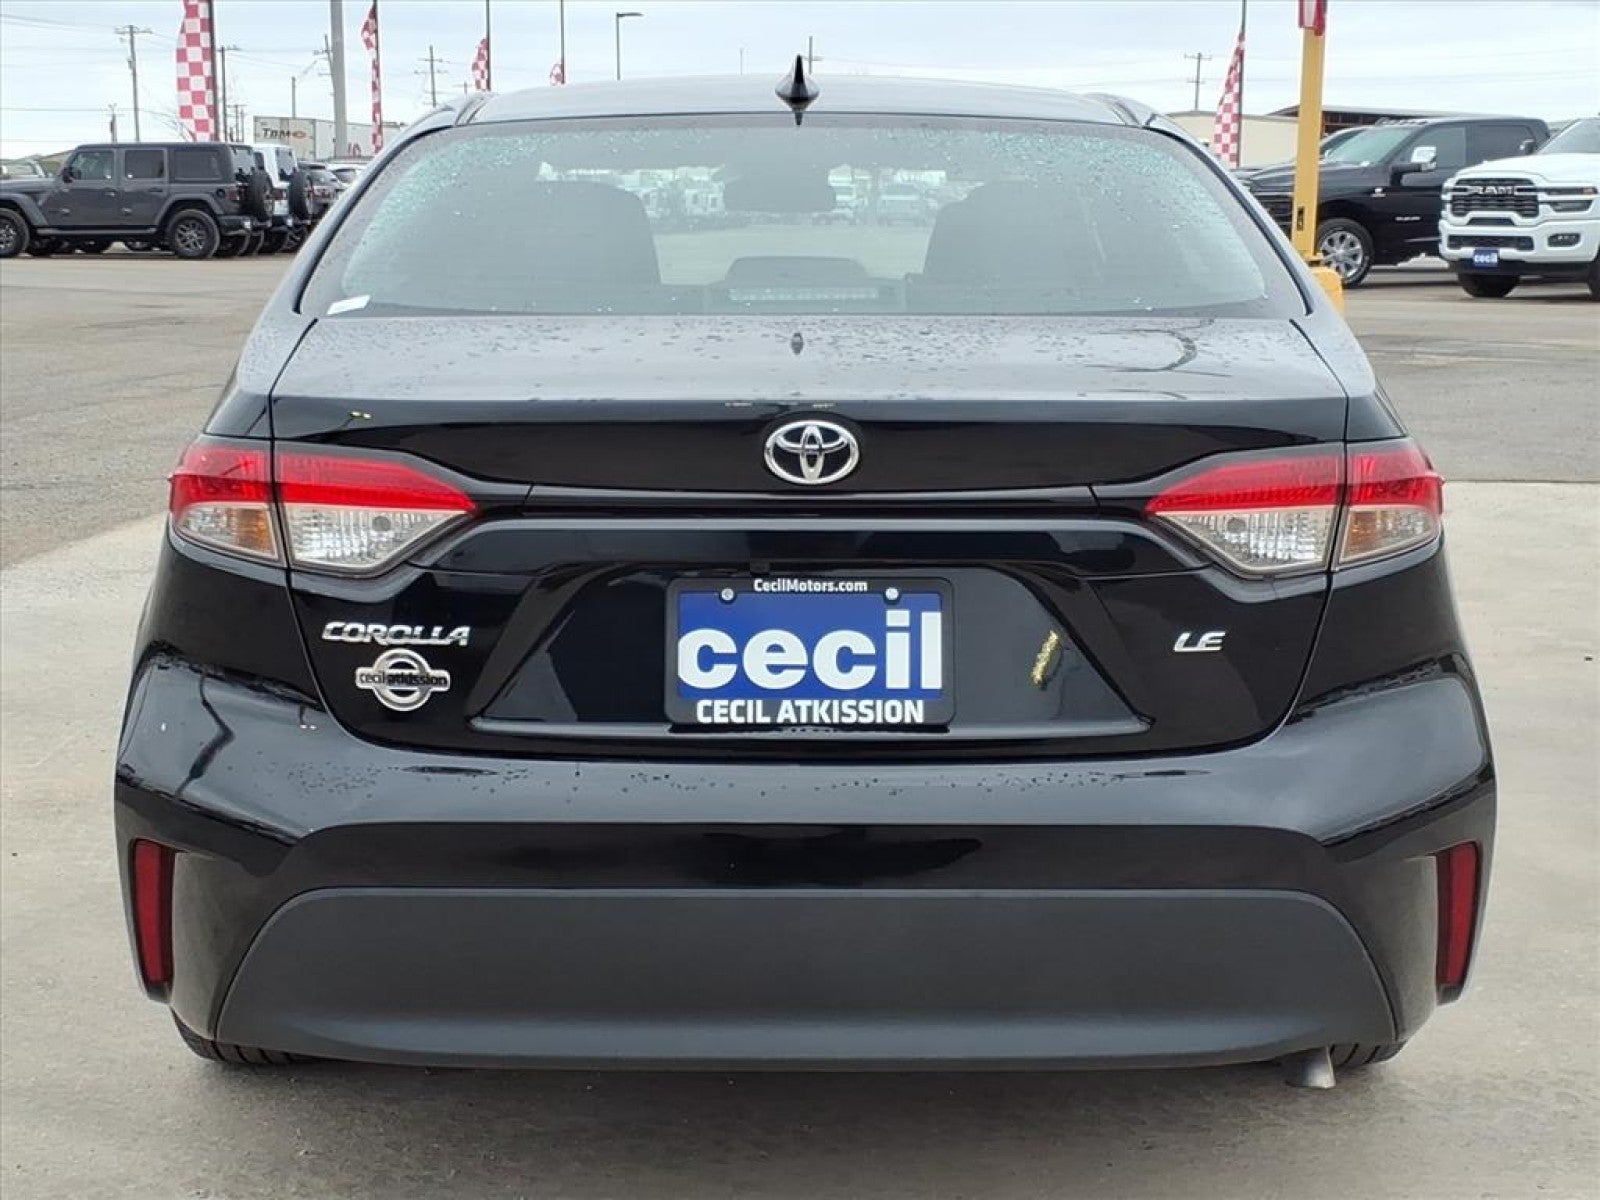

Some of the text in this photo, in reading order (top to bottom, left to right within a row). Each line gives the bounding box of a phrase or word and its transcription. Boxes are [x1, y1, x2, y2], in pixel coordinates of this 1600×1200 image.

[753, 578, 868, 592] CecilMotors.com
[322, 622, 470, 646] COROLLA
[1173, 631, 1226, 652] LE
[677, 609, 942, 690] cecil
[696, 699, 925, 724] CECIL ATKISSION
